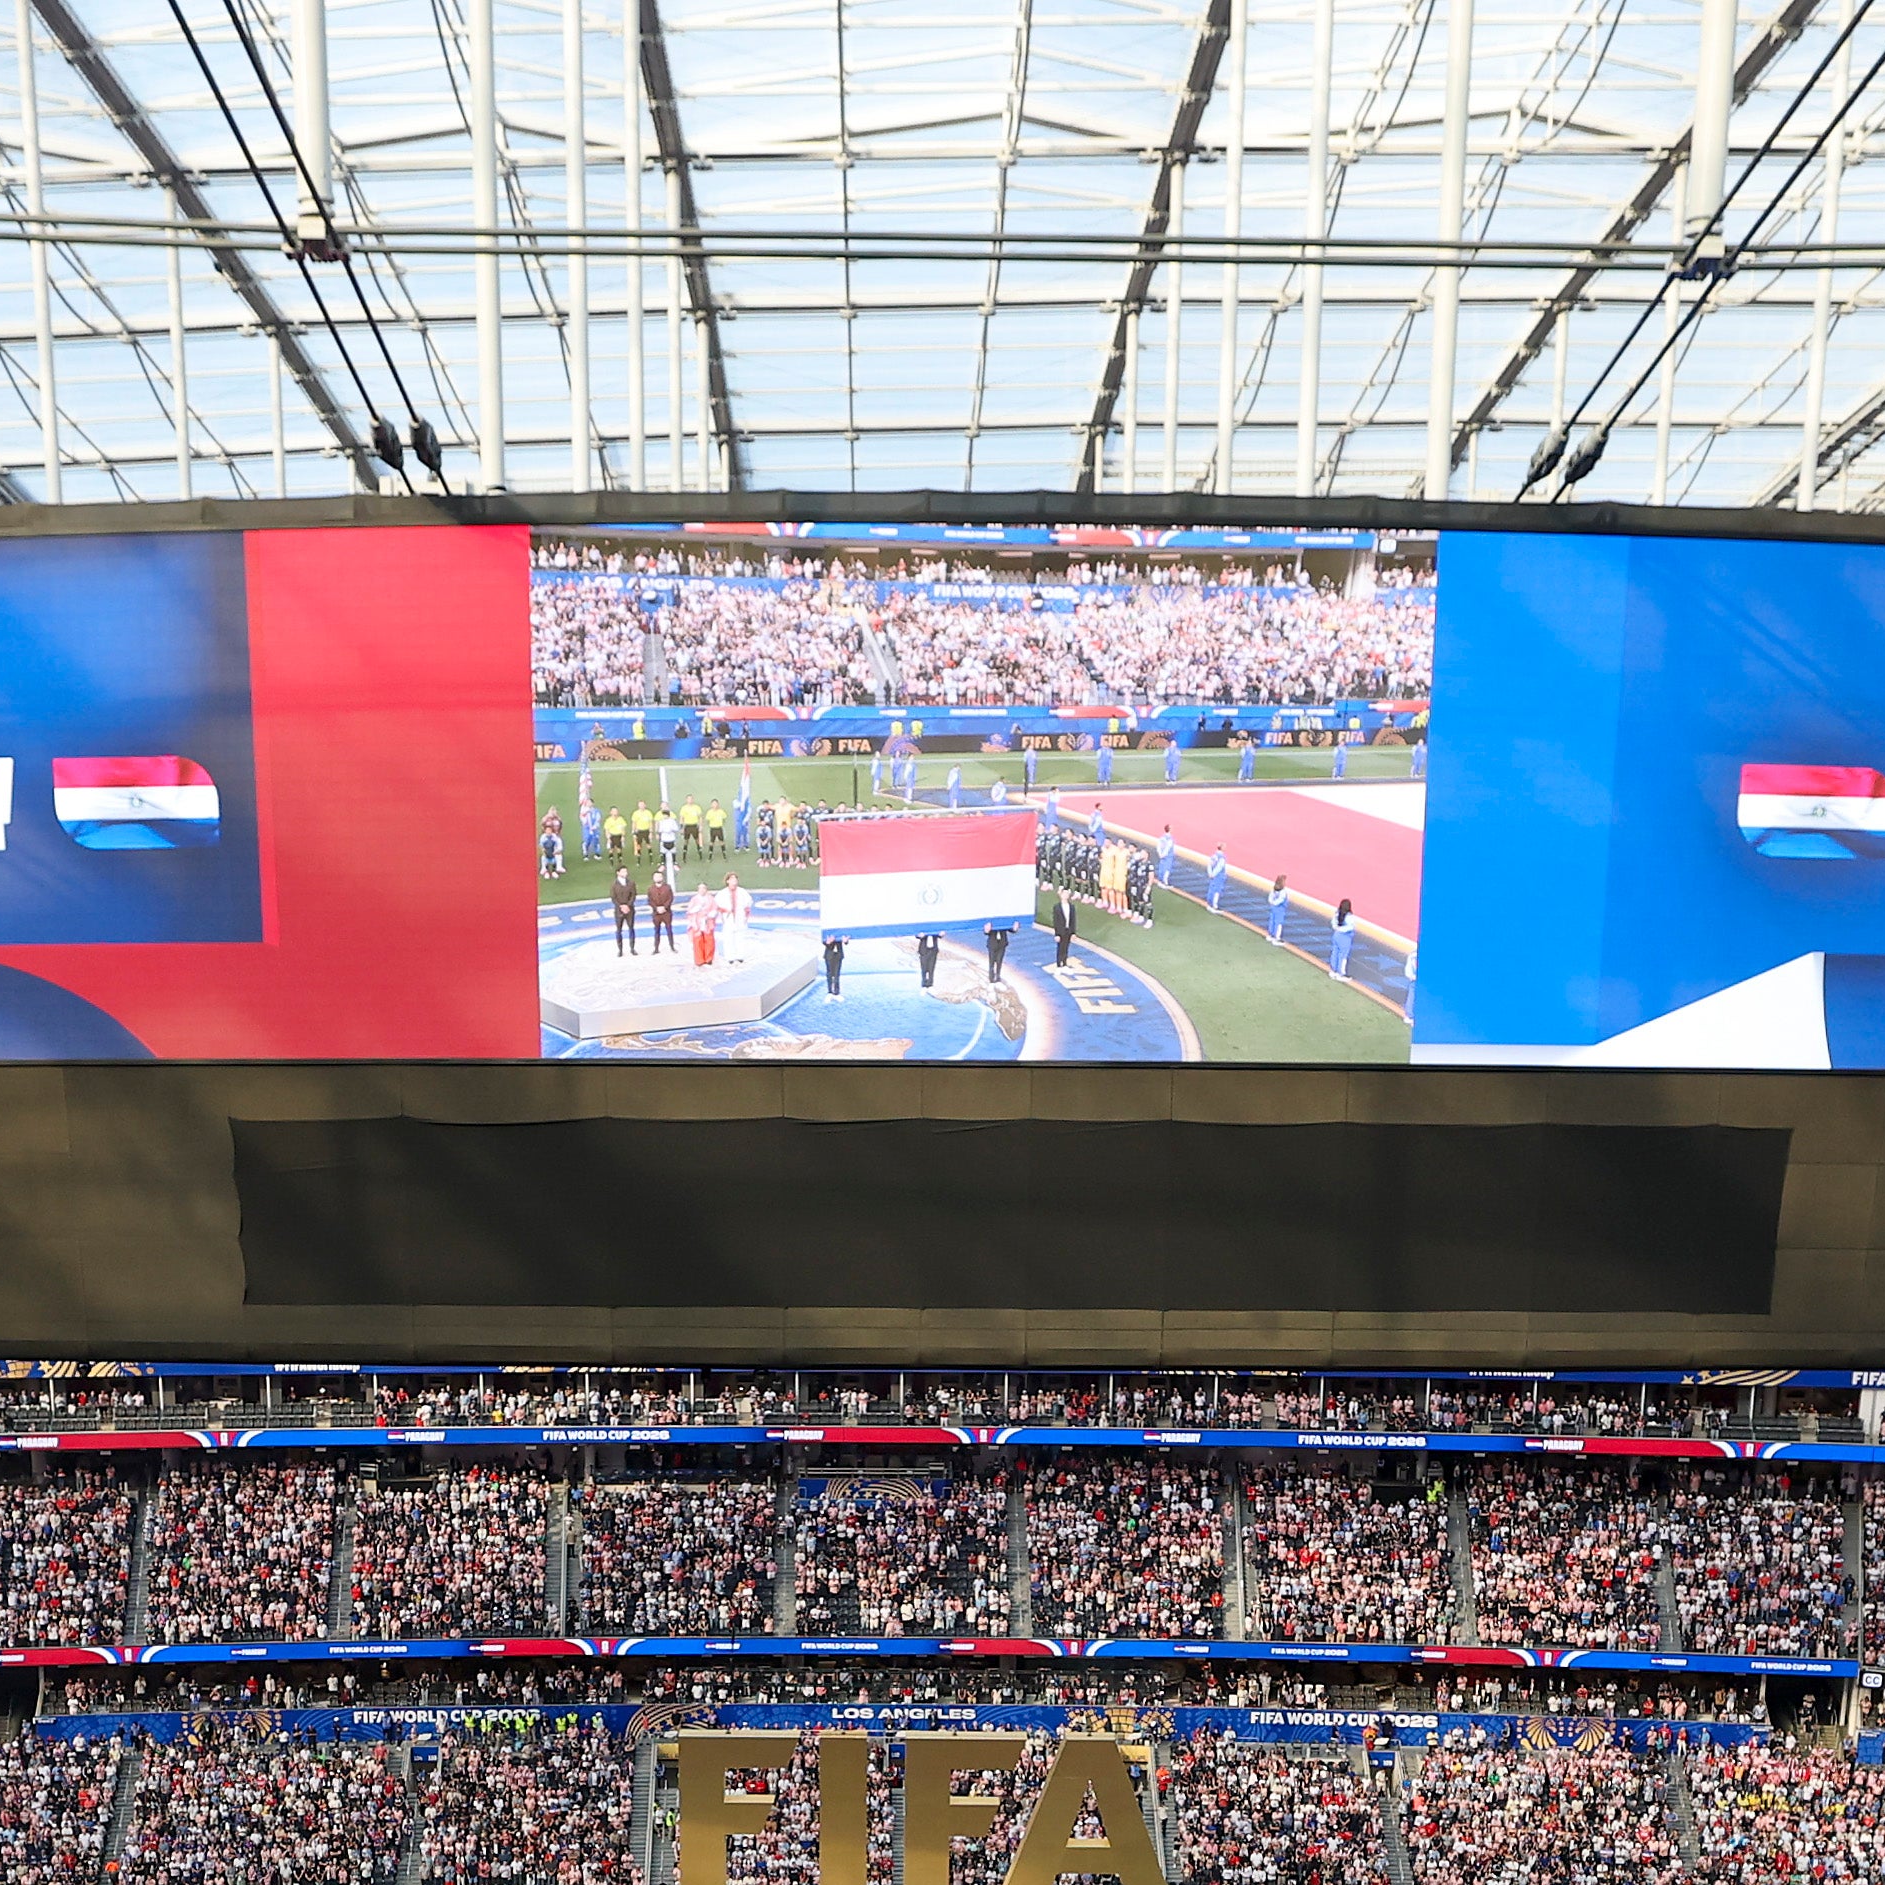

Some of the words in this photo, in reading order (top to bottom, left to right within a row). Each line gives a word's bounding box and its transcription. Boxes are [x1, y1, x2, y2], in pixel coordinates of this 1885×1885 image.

[749, 739, 783, 753] FIFA
[838, 738, 871, 752] FIFA
[1041, 956, 1139, 1014] FIFA
[543, 1431, 567, 1442] FIFA
[567, 1431, 608, 1442] WORLD
[608, 1431, 631, 1442] CUP
[631, 1431, 670, 1442] 2026
[1298, 1434, 1323, 1446] FIFA
[1323, 1435, 1364, 1446] WORLD
[1364, 1436, 1387, 1447] CUP
[1387, 1436, 1427, 1448] 2026
[1865, 1676, 1881, 1685] CC
[353, 1709, 389, 1724] FIFA
[389, 1709, 450, 1724] WORLD
[832, 1707, 874, 1720] LOS
[1250, 1711, 1286, 1725] FIFA
[1286, 1712, 1344, 1726] WORLD
